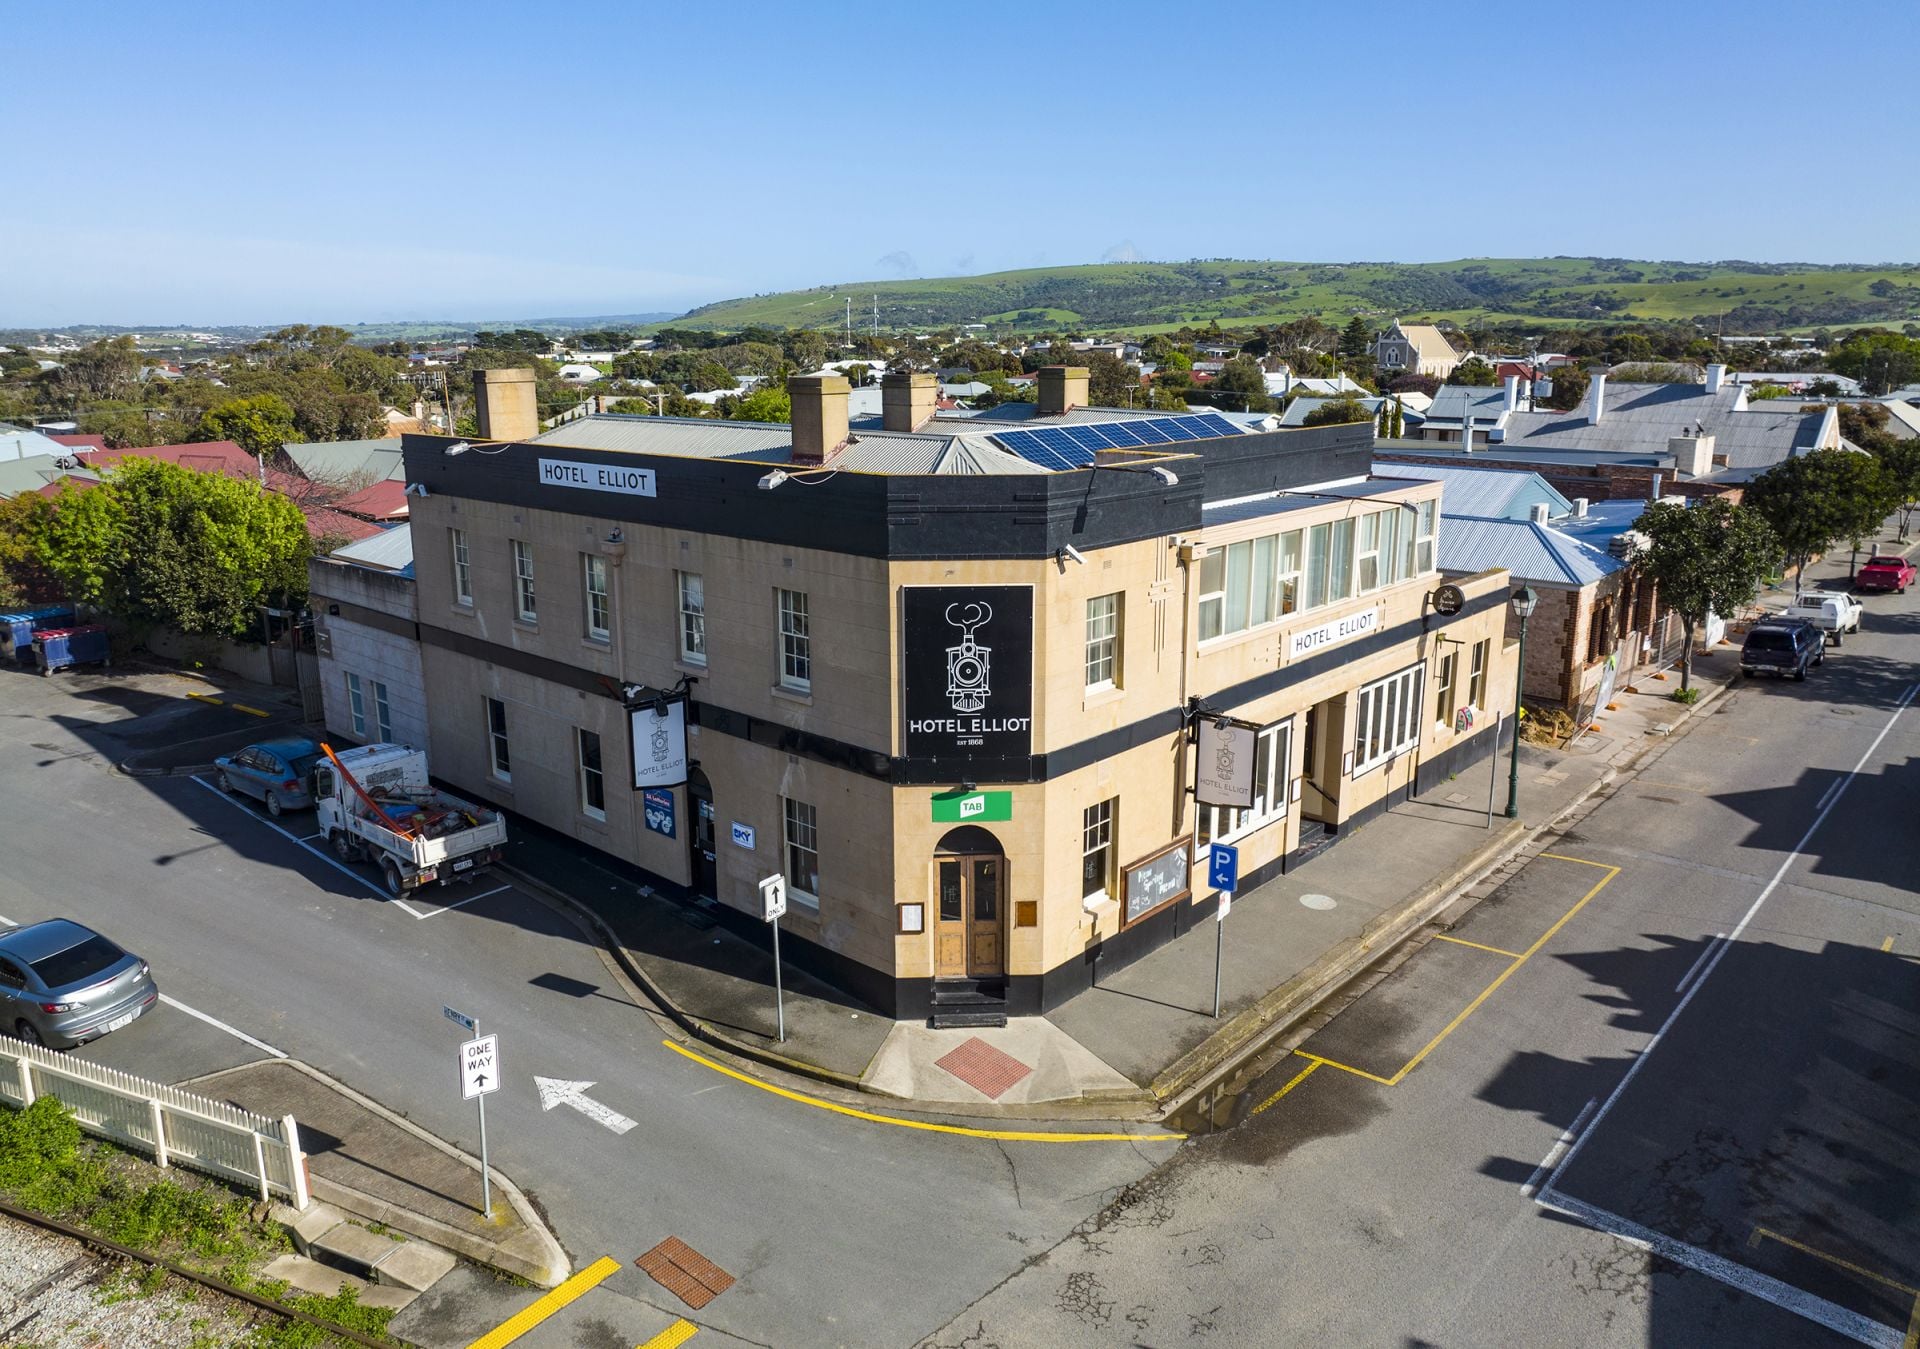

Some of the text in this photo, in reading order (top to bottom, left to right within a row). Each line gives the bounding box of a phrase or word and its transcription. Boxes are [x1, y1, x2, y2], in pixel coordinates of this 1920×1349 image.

[544, 464, 648, 490] HOTEL ELLIOT
[1295, 613, 1374, 652] HOTEL ELLIOT
[910, 718, 1030, 733] HOTEL ELLIOT
[637, 766, 660, 777] HOTEL
[661, 758, 684, 770] ELLIOT
[1199, 777, 1223, 789] HOTEL
[1224, 783, 1248, 795] ELLIOT
[962, 802, 982, 811] TAB
[733, 828, 751, 842] SKY
[1215, 851, 1231, 870] P
[767, 903, 785, 917] ONLY
[468, 1042, 492, 1057] ONE
[467, 1055, 492, 1071] WAY
